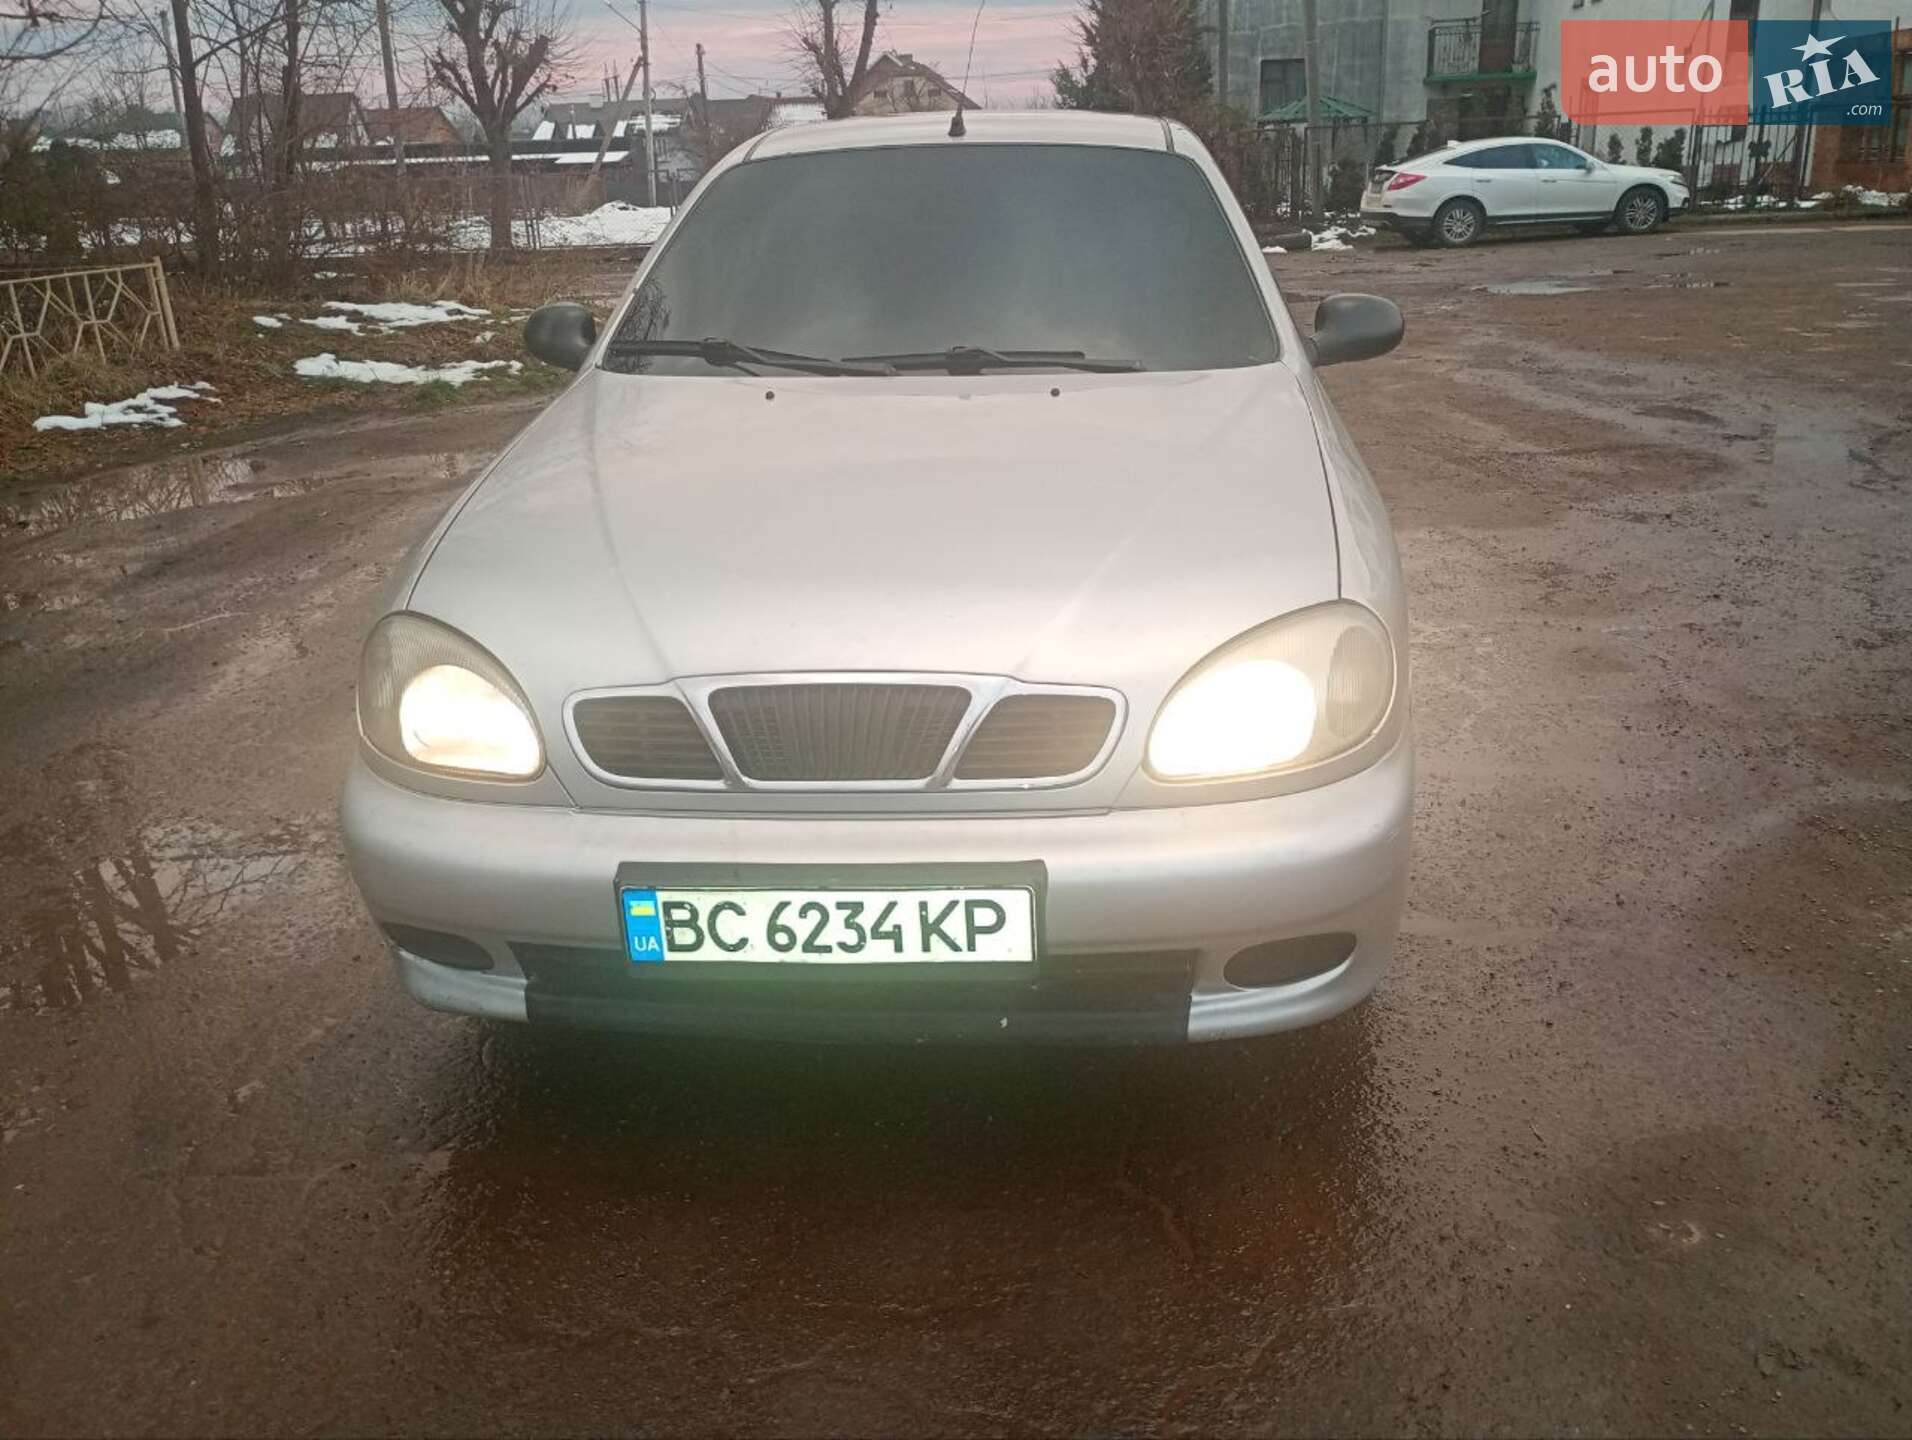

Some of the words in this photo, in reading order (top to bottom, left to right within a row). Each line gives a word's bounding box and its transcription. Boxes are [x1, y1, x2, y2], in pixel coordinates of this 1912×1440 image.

[662, 901, 749, 953] BC
[766, 901, 904, 954] 6234
[919, 900, 1007, 953] KP
[634, 938, 660, 952] UA
